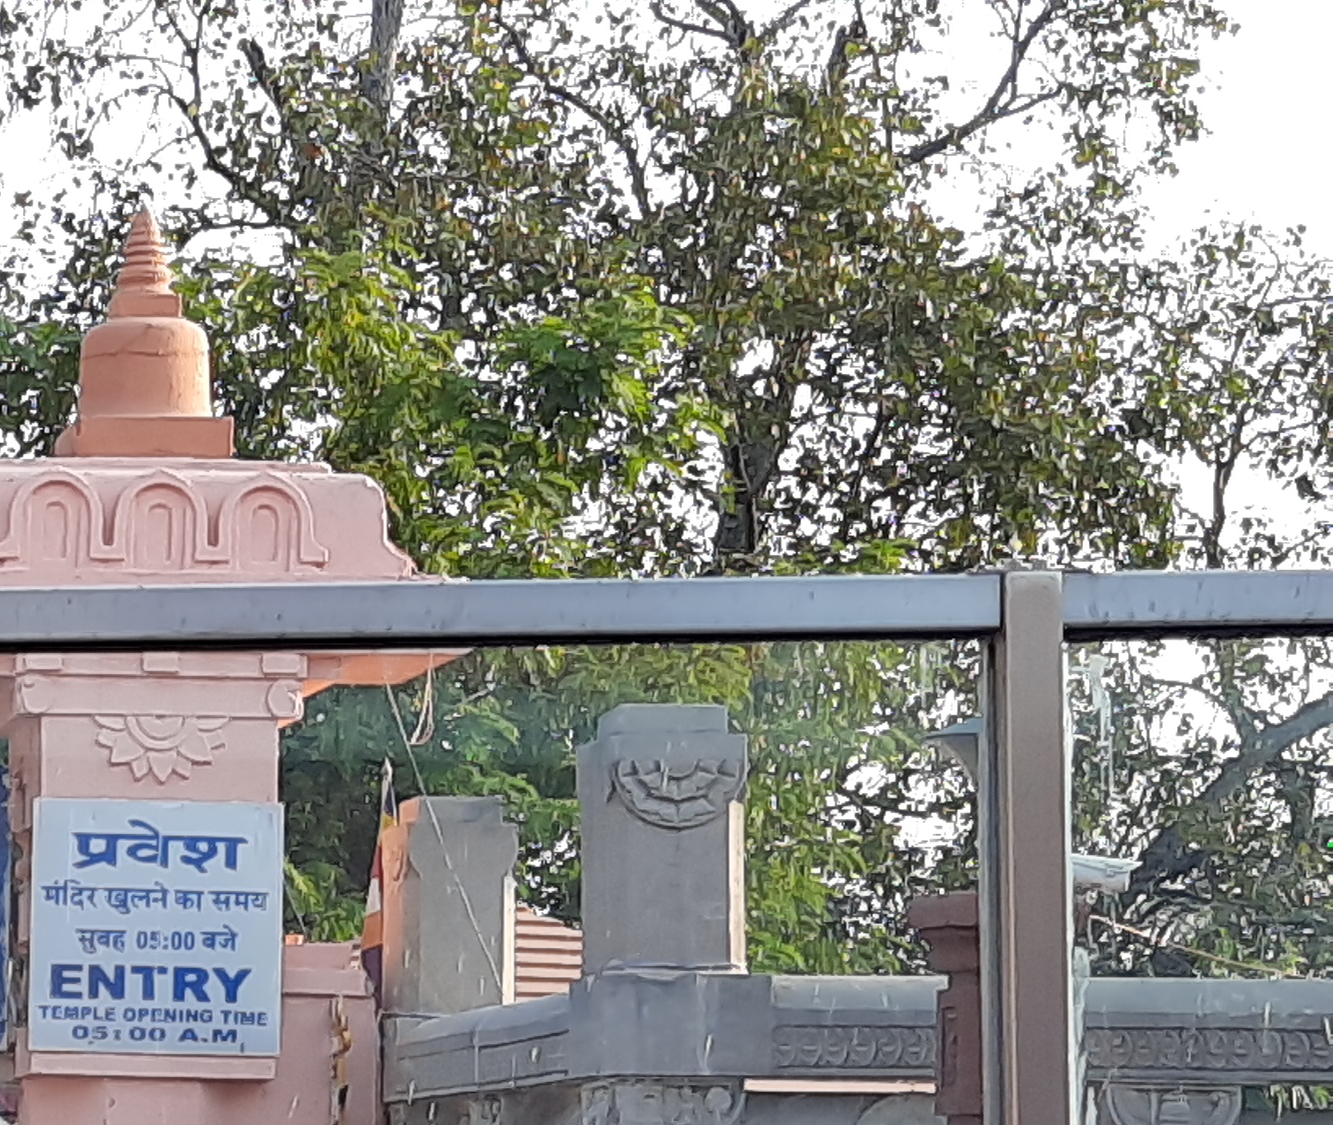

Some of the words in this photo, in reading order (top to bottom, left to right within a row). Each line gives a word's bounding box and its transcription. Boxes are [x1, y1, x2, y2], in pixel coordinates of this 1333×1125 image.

[71, 818, 249, 873] प्रवेश
[41, 879, 98, 912] मंदिर
[103, 880, 169, 915] खुलने
[173, 889, 205, 912] का
[209, 890, 270, 912] समय
[48, 963, 252, 1004] ENTRY
[38, 1004, 116, 1021] TEMPLE
[122, 1007, 213, 1024] OPENING
[220, 1010, 269, 1027] TIME
